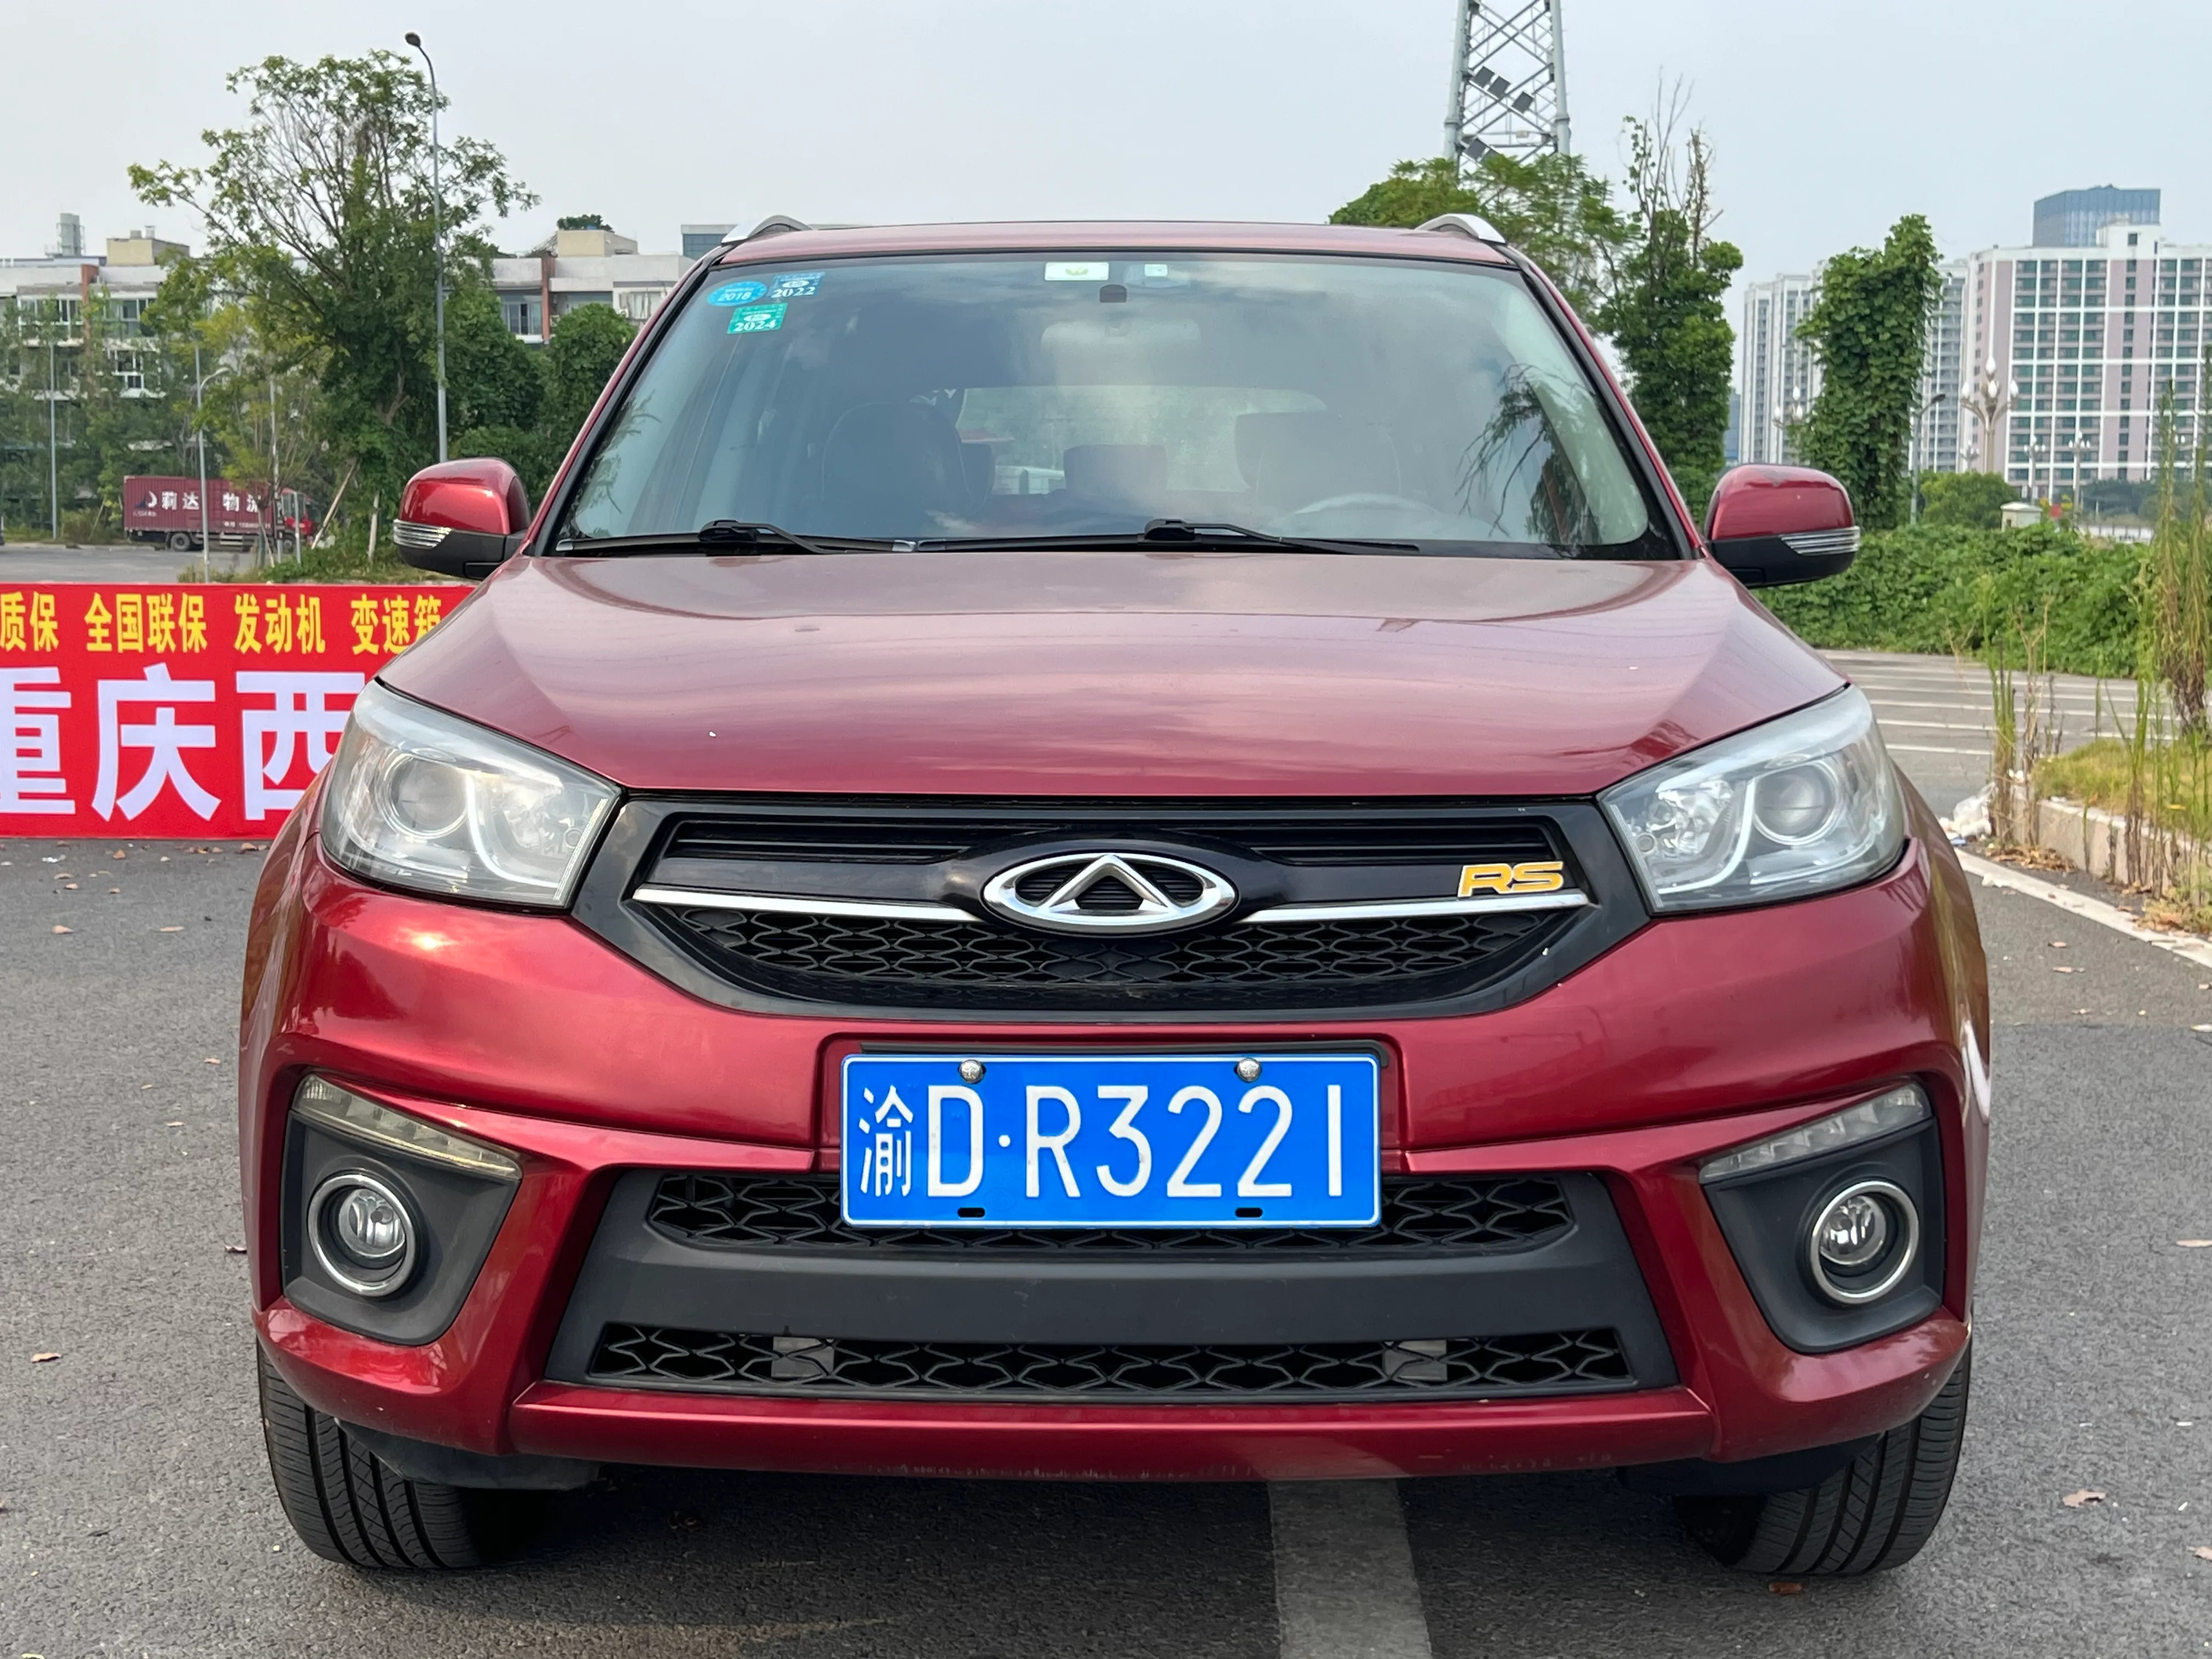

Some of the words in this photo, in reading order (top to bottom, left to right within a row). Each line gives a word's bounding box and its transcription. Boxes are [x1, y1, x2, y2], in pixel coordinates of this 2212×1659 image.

[717, 291, 752, 302] 2018
[771, 286, 816, 299] 2022
[732, 319, 777, 332] 2024
[0, 591, 59, 652] 质保
[84, 592, 208, 654] 全国联保
[234, 593, 326, 654] 发动机
[351, 593, 442, 655] 变速箱
[1458, 861, 1564, 898] RS
[859, 1084, 1342, 1198] 渝D·R3221
